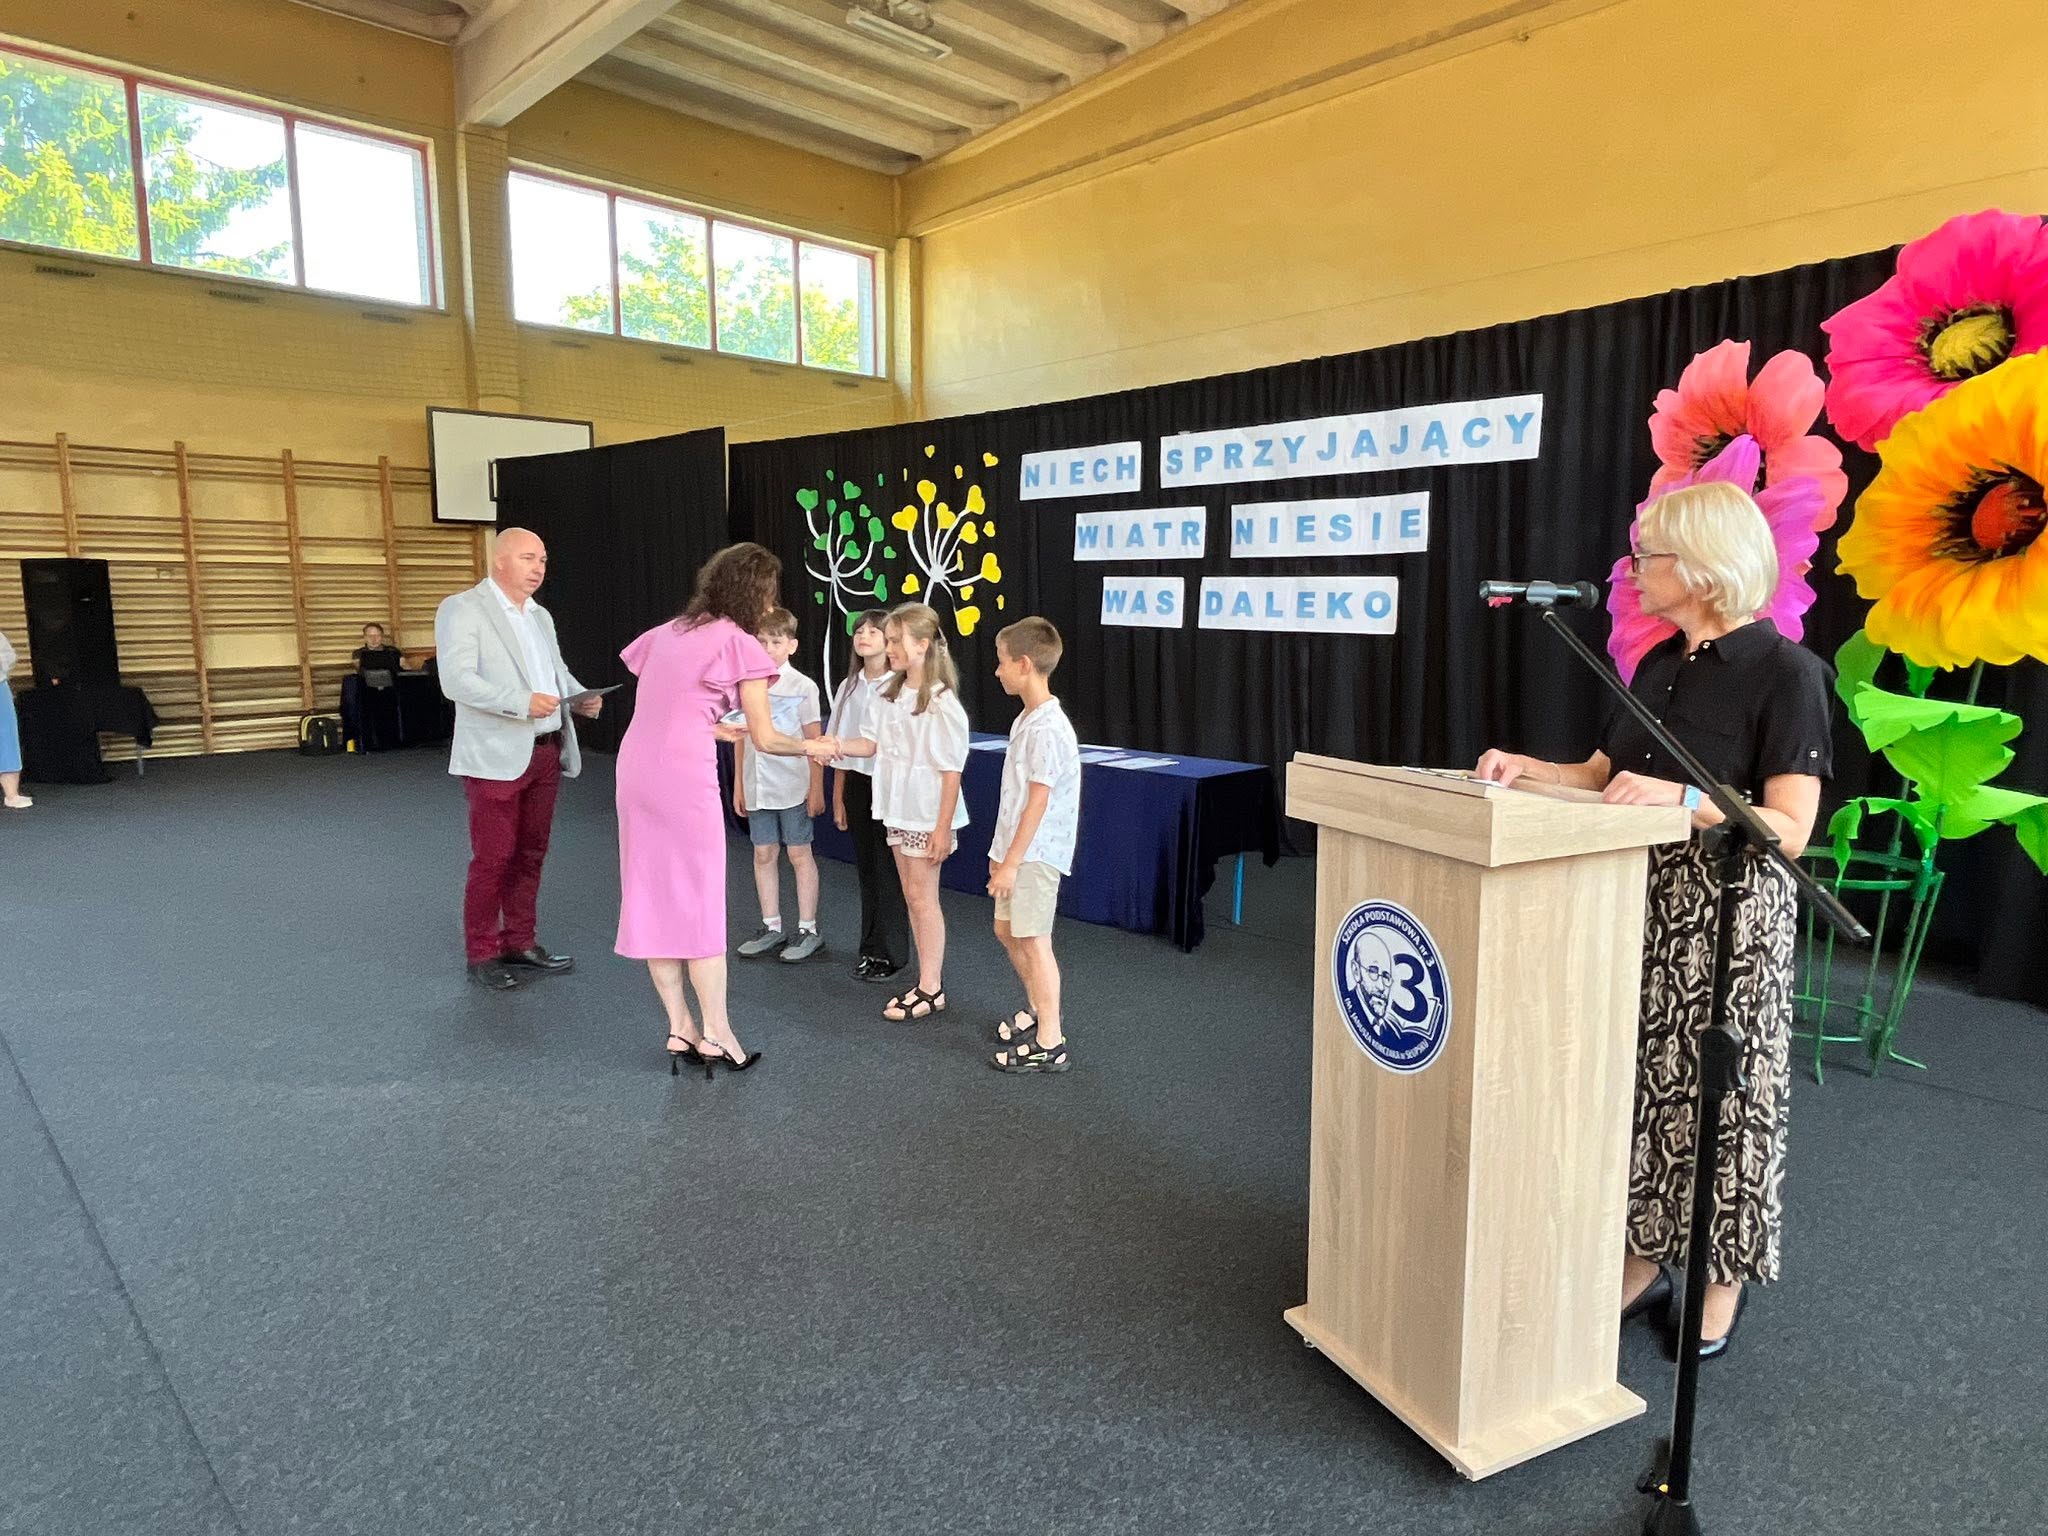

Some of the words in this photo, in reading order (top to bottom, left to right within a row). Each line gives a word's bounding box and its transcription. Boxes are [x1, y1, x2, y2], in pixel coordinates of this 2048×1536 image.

[1024, 454, 1136, 488] NIECH
[1166, 411, 1535, 475] SPRZYJAJĄCY
[1076, 520, 1201, 549] WIATR
[1235, 508, 1422, 545] NIESIE
[1104, 589, 1175, 615] WAS
[1205, 589, 1391, 619] DALEKO
[1342, 915, 1365, 945] SZKOŁA
[1364, 911, 1420, 945] PODSTAWOWA
[1425, 956, 1435, 967] 3
[1391, 953, 1428, 1024] 3
